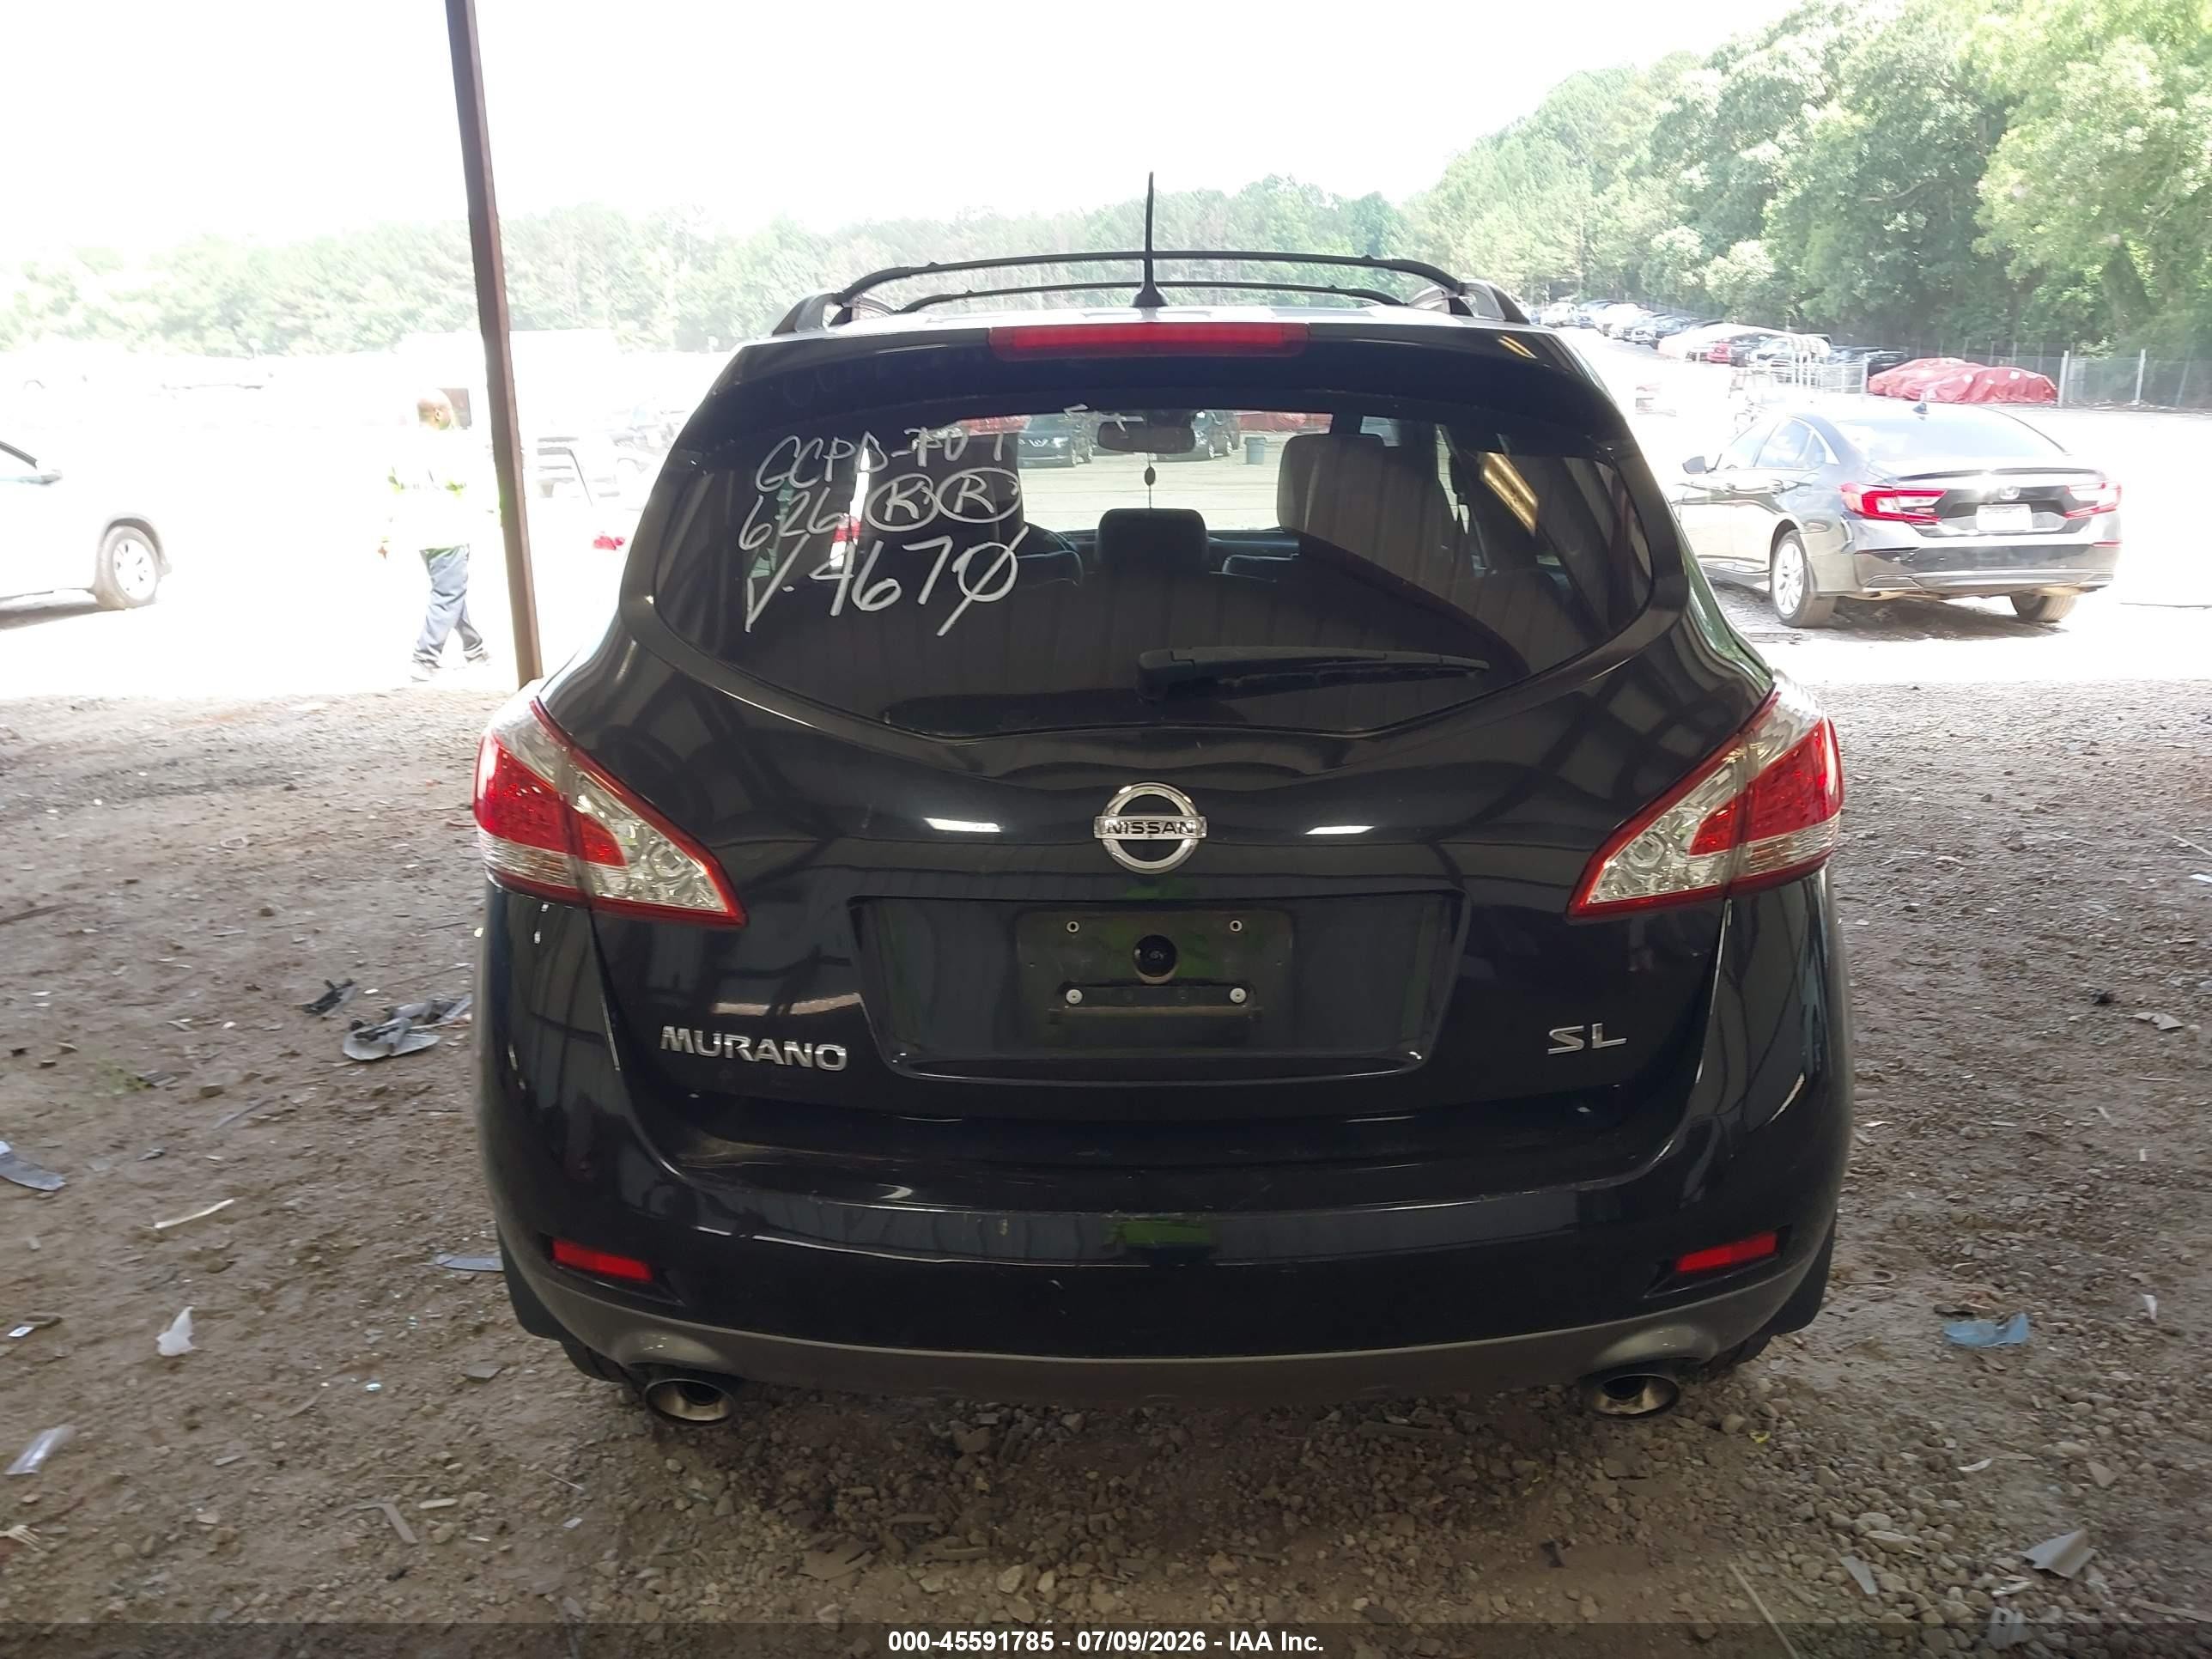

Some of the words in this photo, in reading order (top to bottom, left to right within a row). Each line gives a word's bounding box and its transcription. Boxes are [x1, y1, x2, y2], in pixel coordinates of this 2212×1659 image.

[1107, 821, 1194, 835] NISSAN
[659, 1025, 848, 1072] MURANO
[1547, 1023, 1628, 1055] SL
